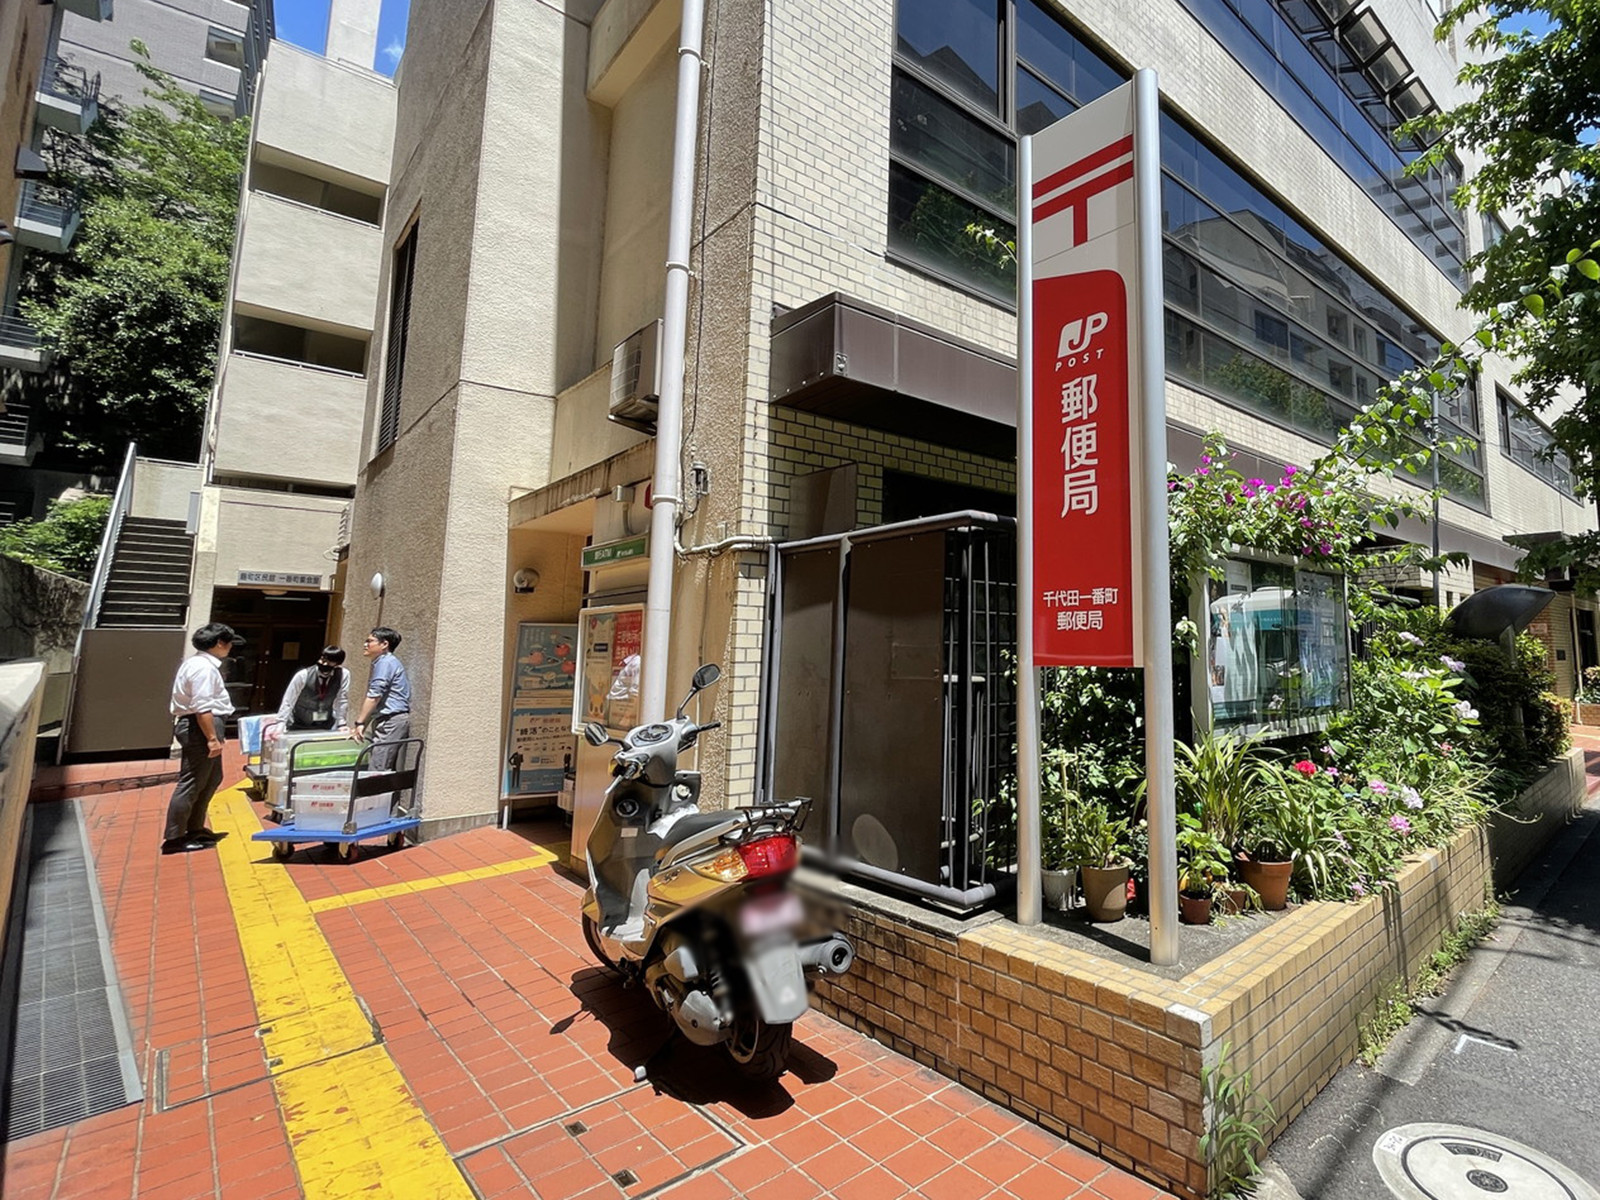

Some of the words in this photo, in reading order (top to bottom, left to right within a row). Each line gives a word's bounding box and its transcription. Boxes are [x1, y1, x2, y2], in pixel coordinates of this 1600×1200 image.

[1057, 311, 1109, 359] JP
[1055, 348, 1104, 372] POST
[1061, 375, 1098, 518] 郵便局
[1043, 587, 1118, 608] 千代田一番町
[1057, 610, 1103, 631] 郵便局
